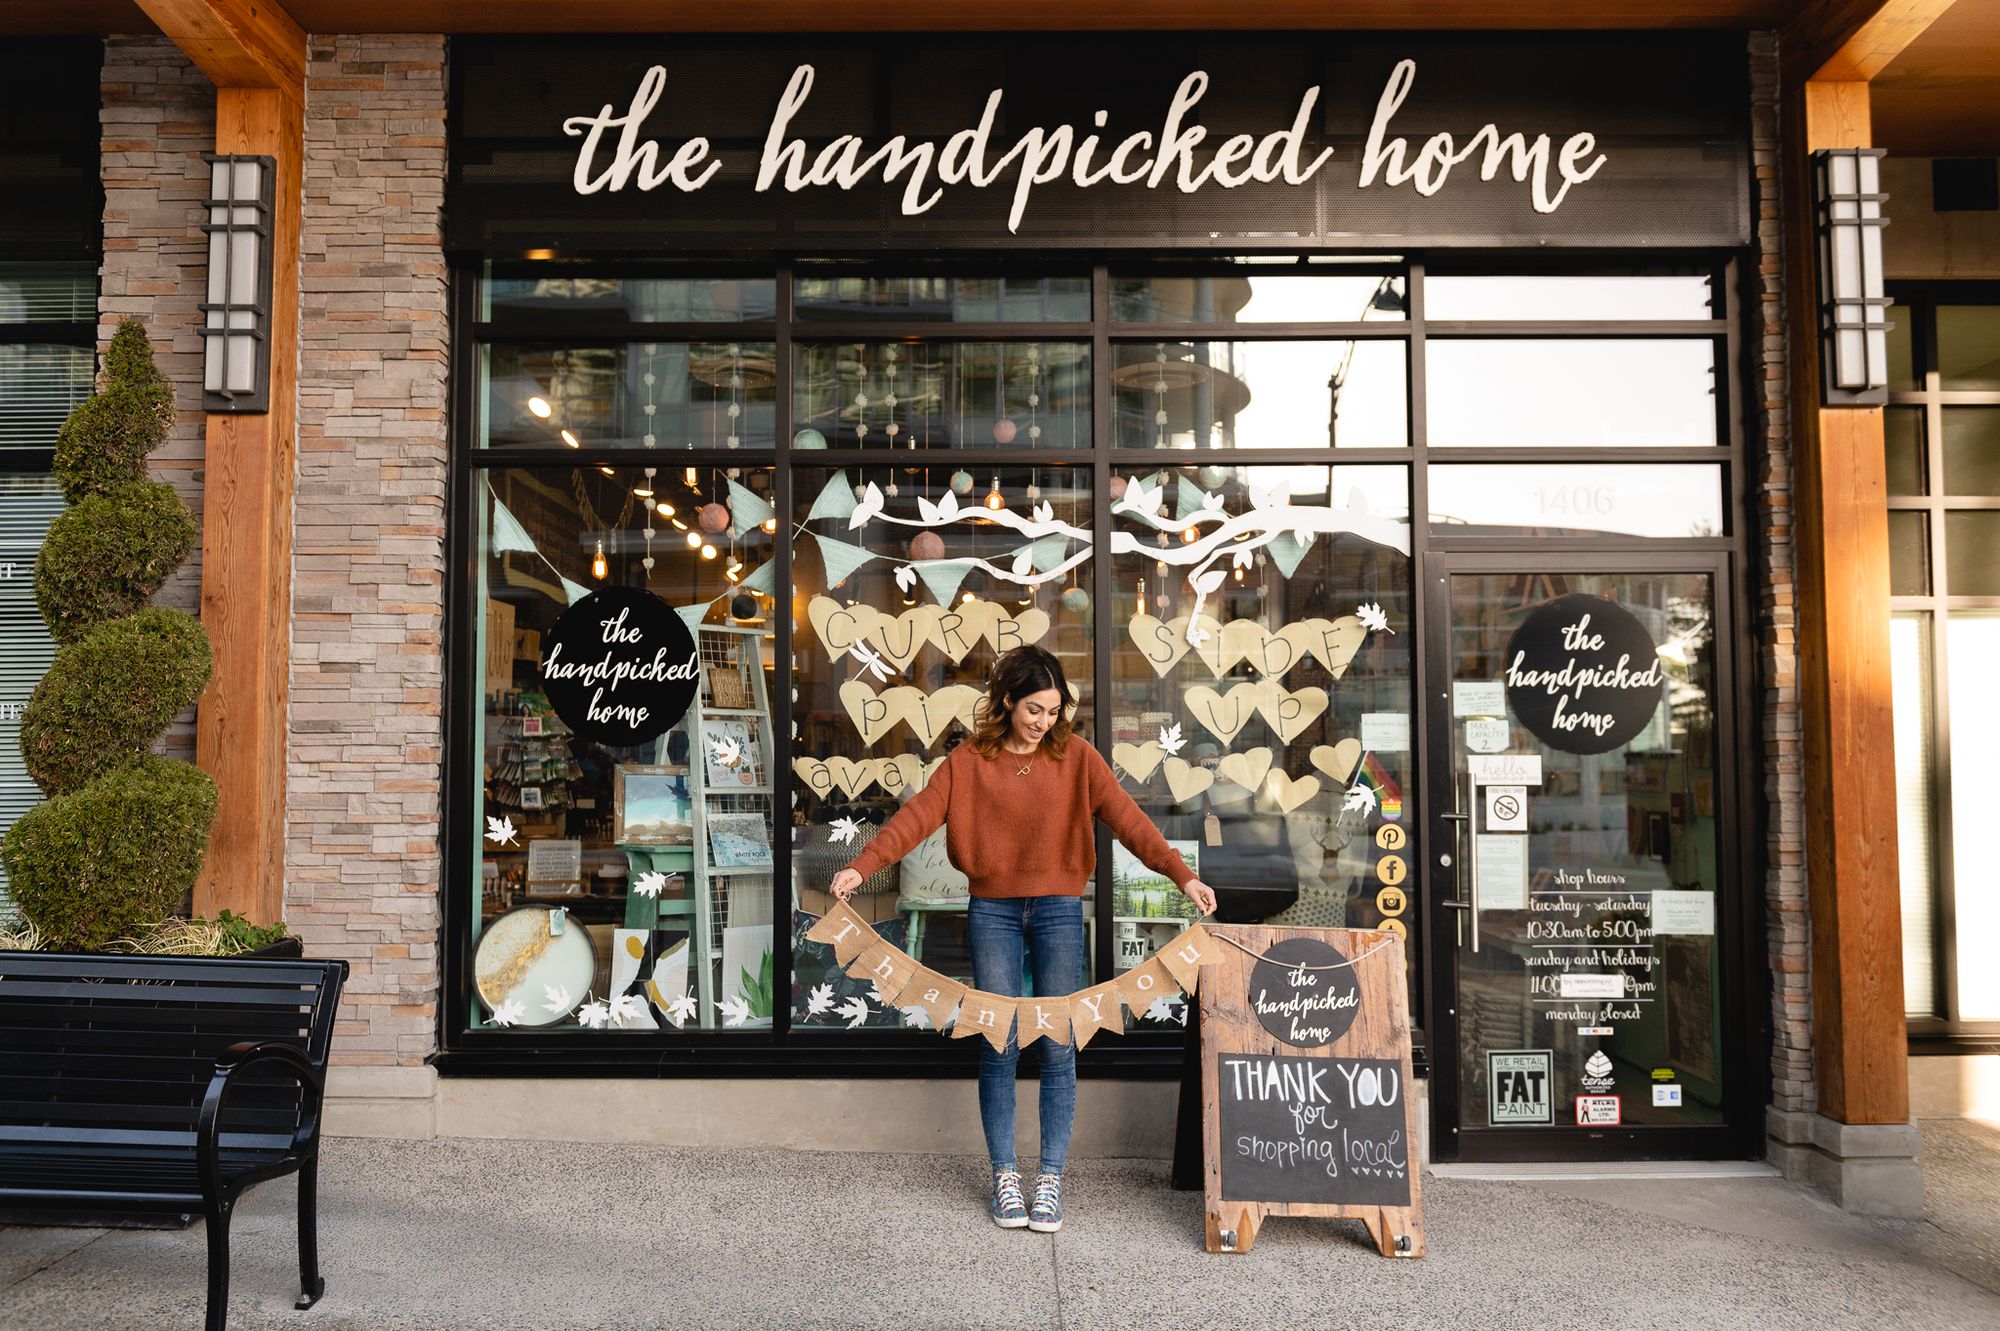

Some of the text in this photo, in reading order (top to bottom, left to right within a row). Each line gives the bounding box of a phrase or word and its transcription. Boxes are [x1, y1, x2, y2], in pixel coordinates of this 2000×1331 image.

[563, 58, 1608, 235] the handpicked home
[600, 606, 644, 644] the
[825, 611, 1024, 659] CURB
[1561, 613, 1605, 651] the
[542, 643, 700, 692] handpicked
[1506, 650, 1663, 700] handpicked
[586, 687, 650, 729] home
[1206, 693, 1302, 738] UP
[1552, 694, 1615, 737] home
[1553, 868, 1626, 890] shop hours
[1528, 895, 1584, 918] tuesday
[1594, 894, 1653, 919] saturday
[1121, 941, 1144, 956] FAT
[1524, 948, 1662, 972] sunday and holidays
[1288, 961, 1318, 988] the
[1255, 985, 1359, 1019] handpicked
[1545, 1002, 1643, 1026] monday closed
[1290, 1016, 1332, 1043] home
[1496, 1057, 1546, 1066] WE RETAIL
[1224, 1059, 1398, 1109] THANK YOU
[1497, 1071, 1546, 1104] FAT
[1289, 1101, 1339, 1136] for
[1497, 1103, 1547, 1116] PAINT
[1343, 1128, 1406, 1168] local
